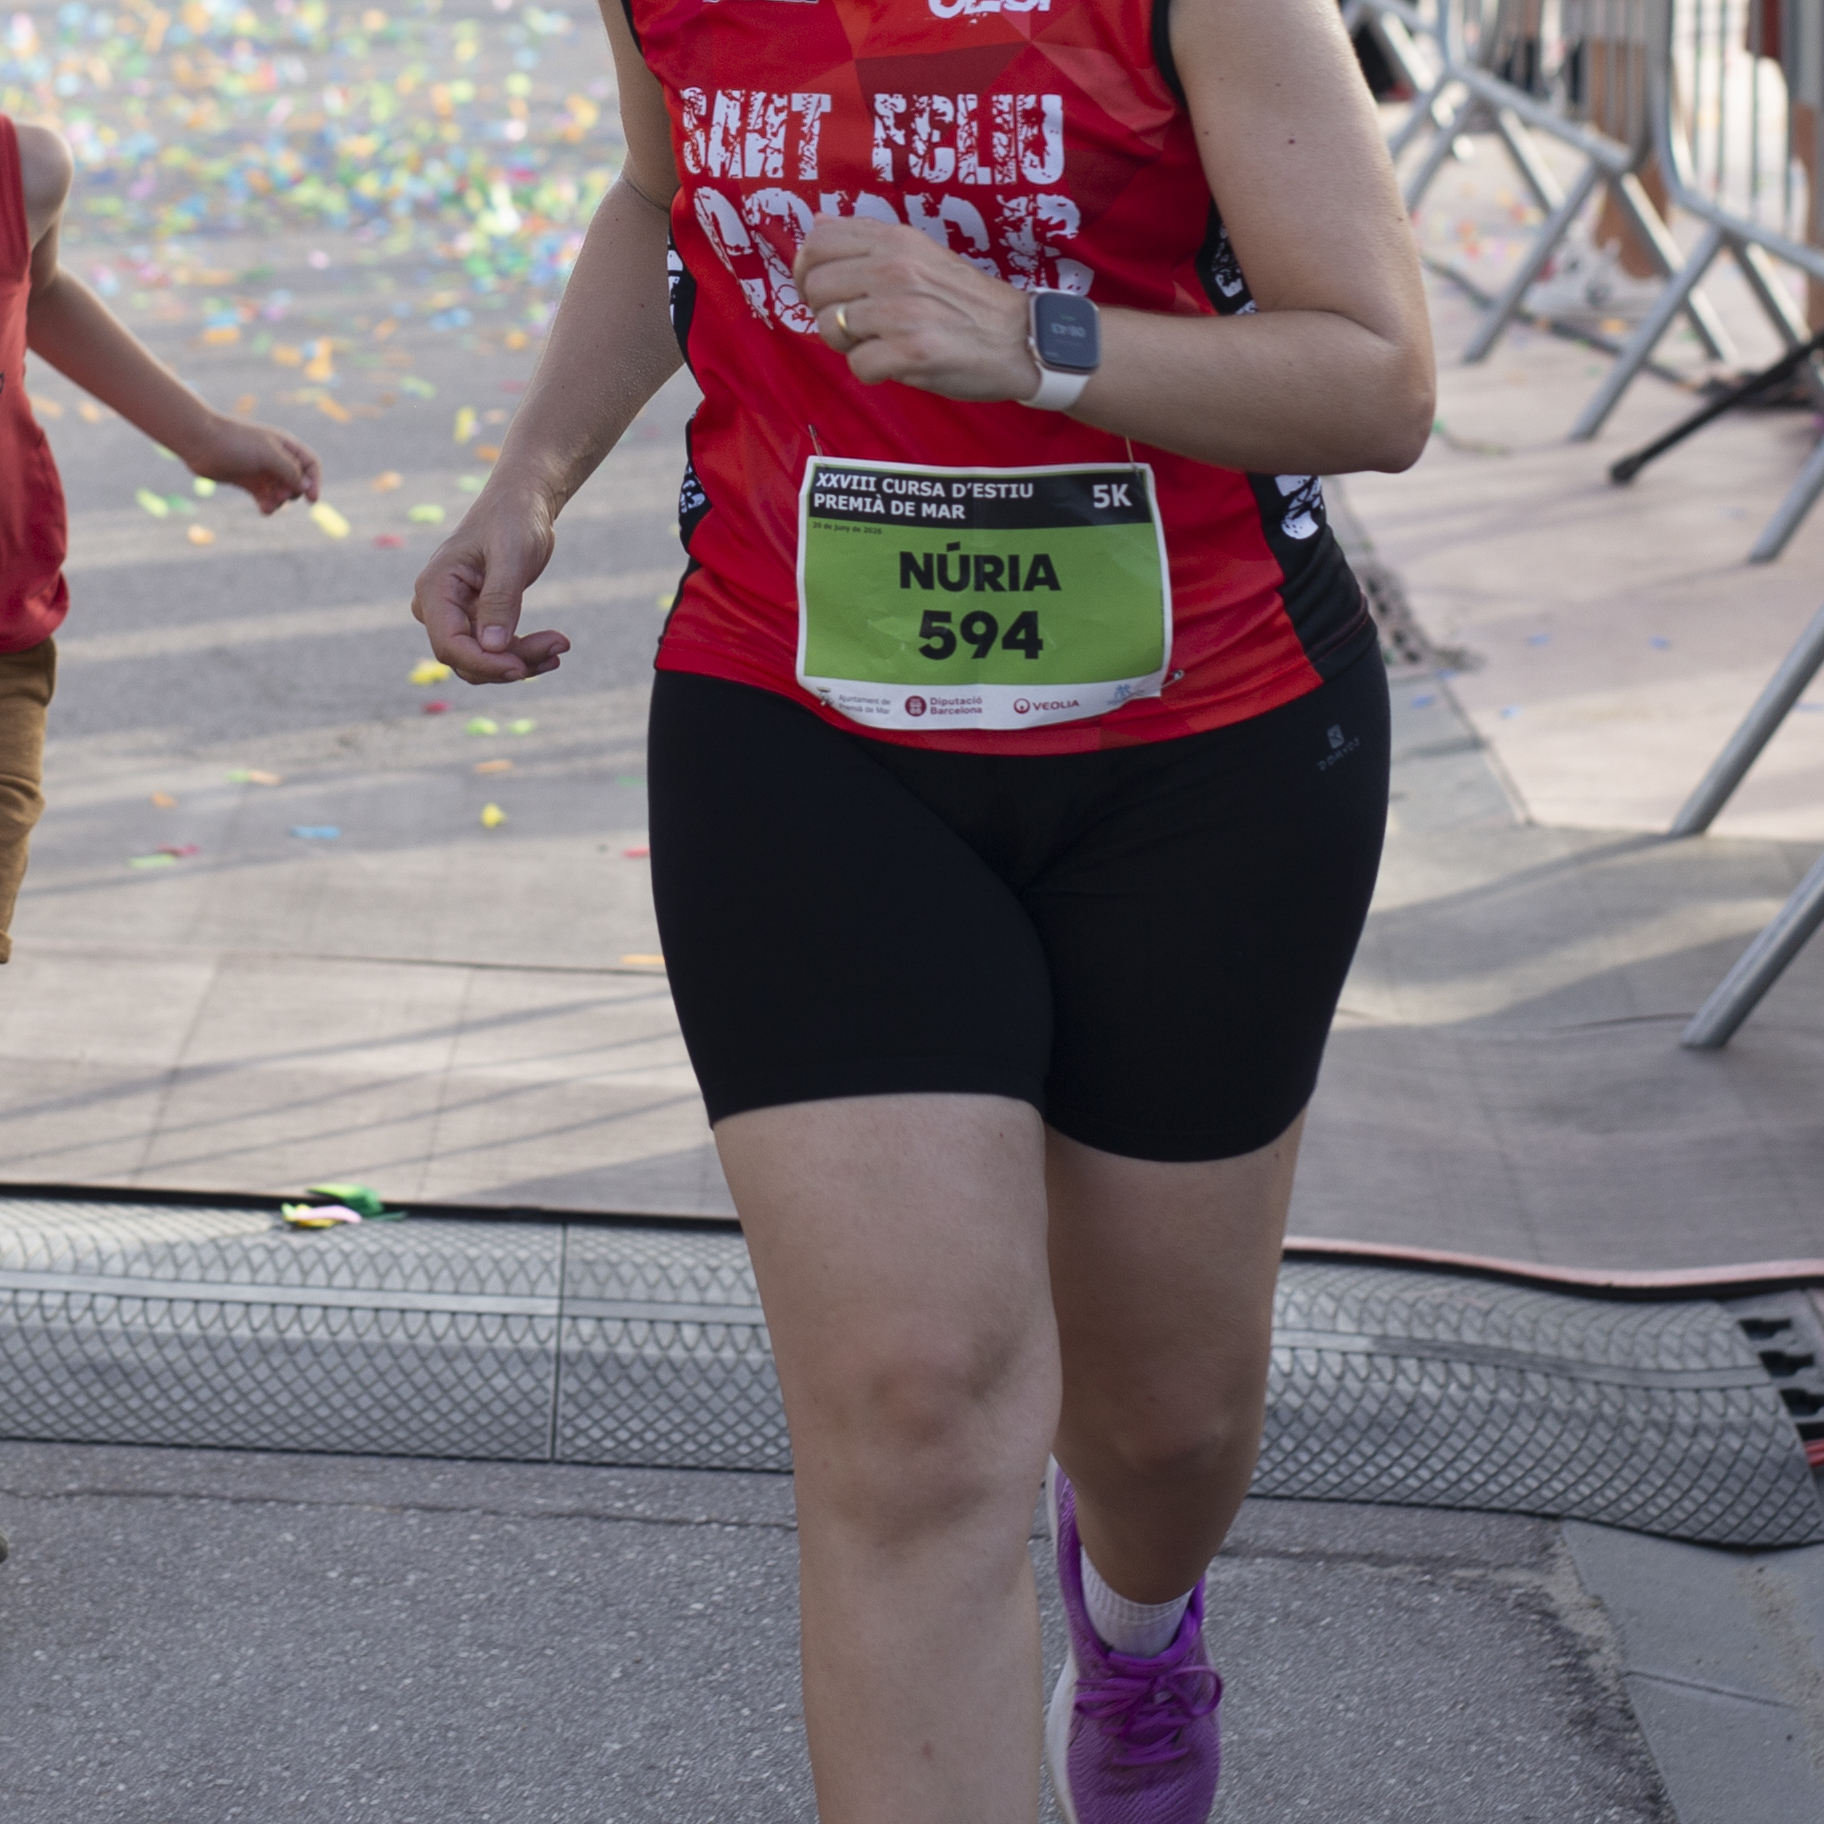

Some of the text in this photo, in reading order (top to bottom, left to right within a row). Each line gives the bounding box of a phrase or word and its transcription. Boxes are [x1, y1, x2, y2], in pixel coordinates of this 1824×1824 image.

[679, 87, 1066, 185] SANT FELIU
[815, 472, 1034, 499] XXVIII CURSA D'ESTIU
[1092, 483, 1133, 509] 5K
[813, 492, 966, 520] PREMIÀ DE MAR
[898, 542, 1062, 593] NÚRIA
[917, 609, 1044, 660] 594
[930, 696, 983, 708] Diputació
[930, 706, 983, 716] Barcelona
[1032, 700, 1080, 711] VEOLIA
